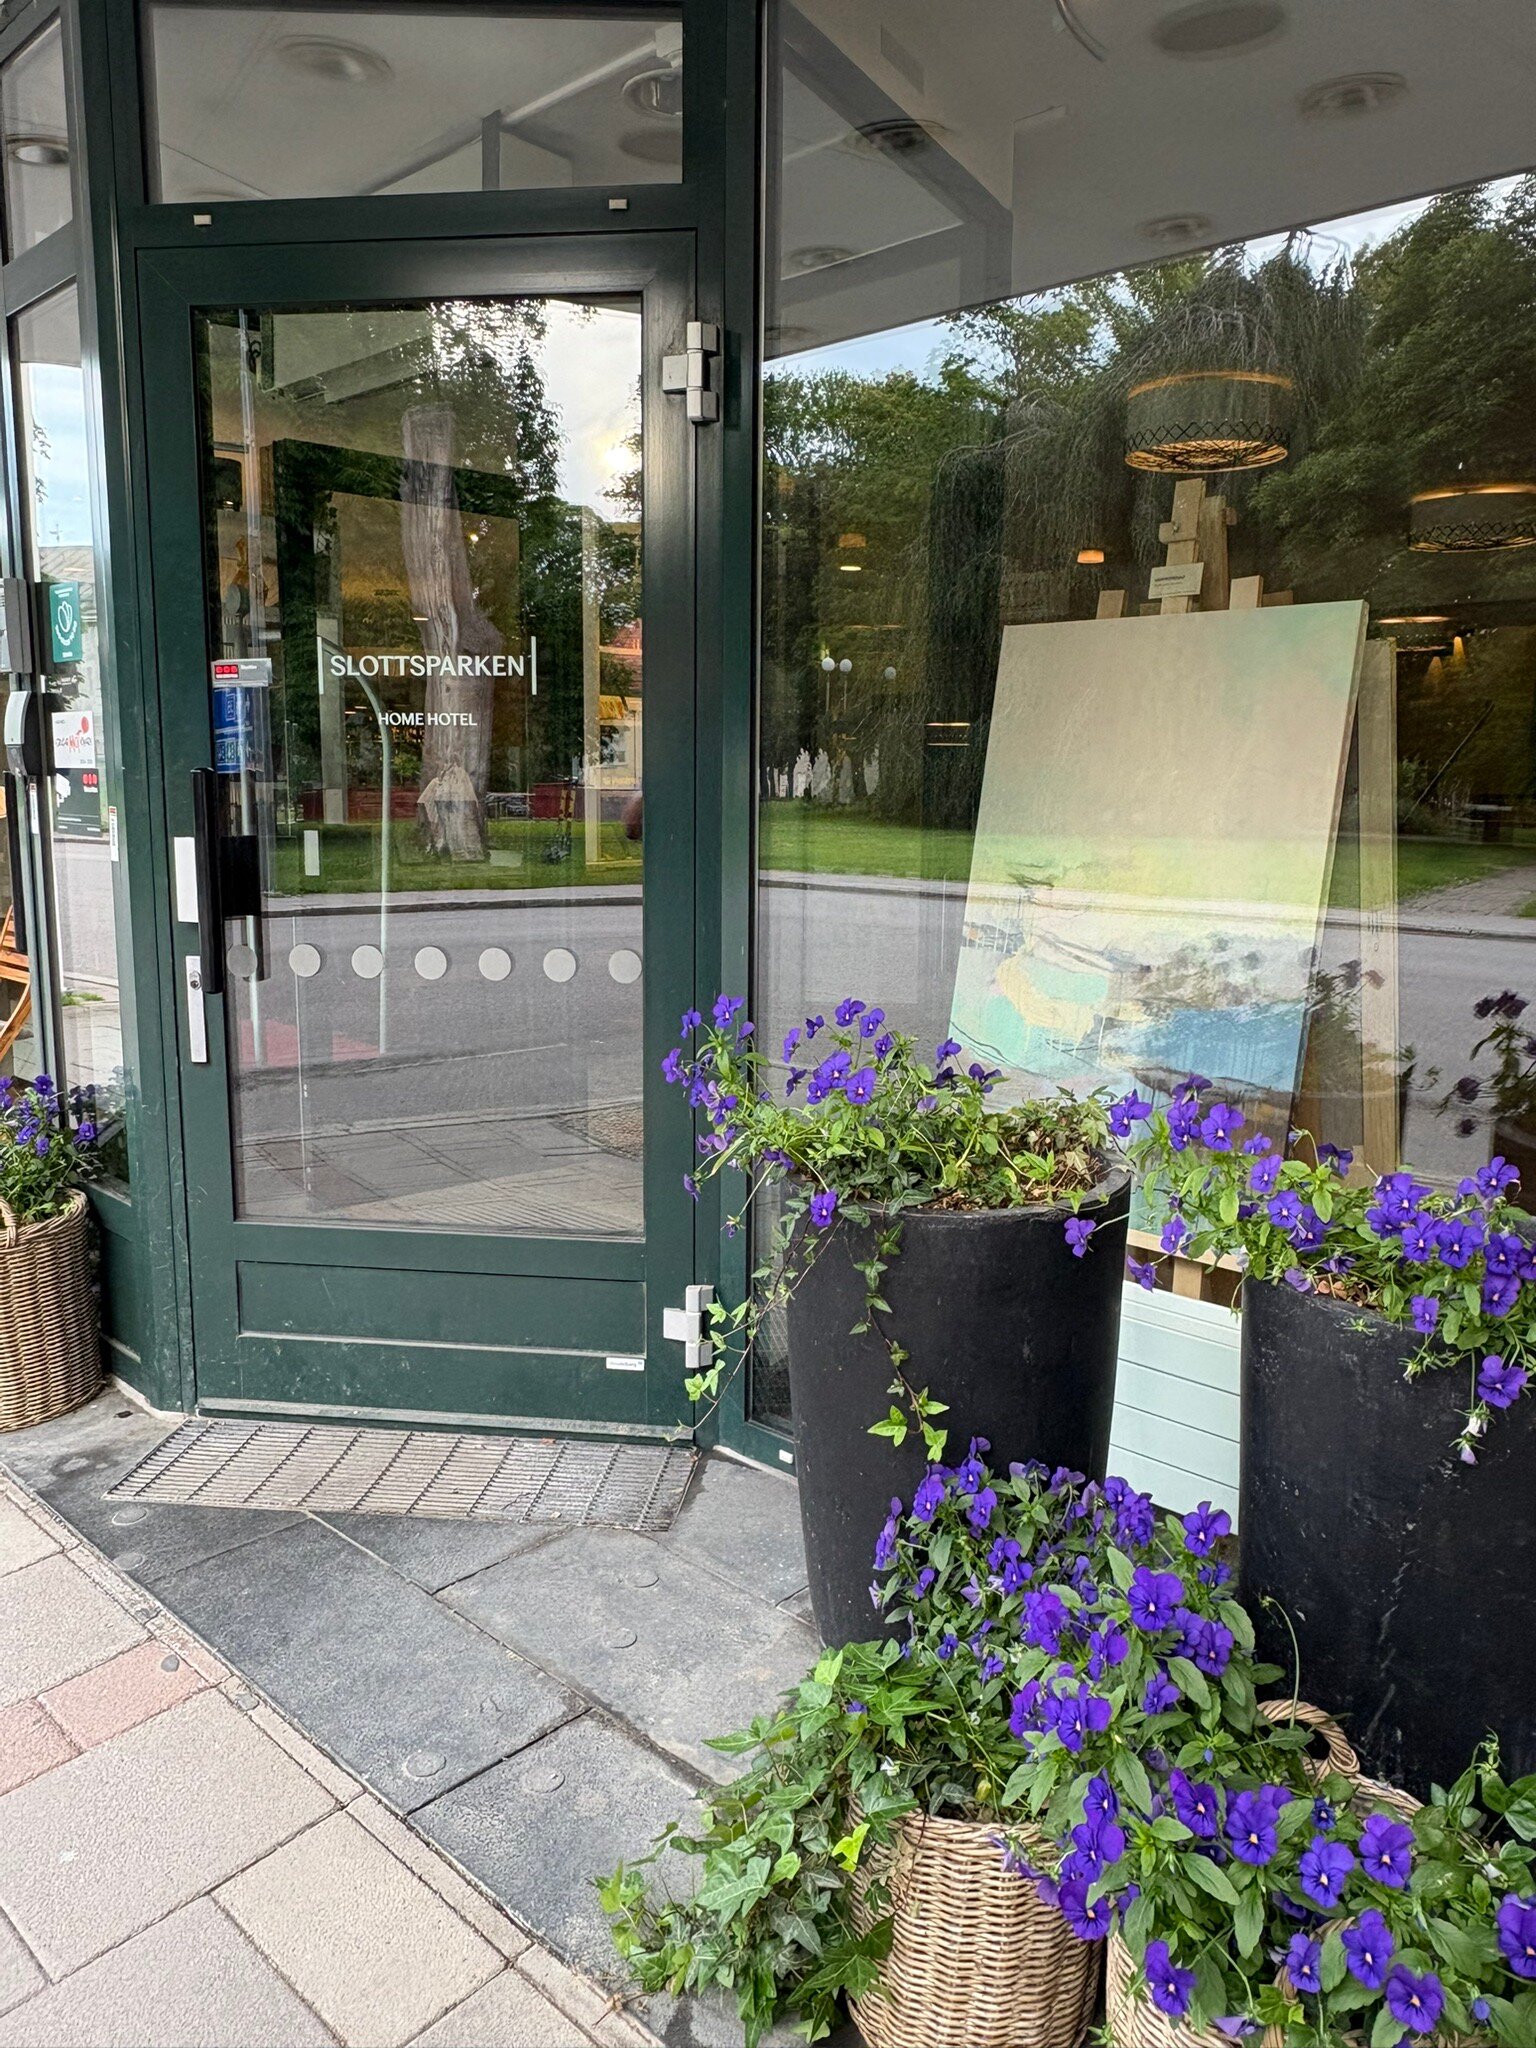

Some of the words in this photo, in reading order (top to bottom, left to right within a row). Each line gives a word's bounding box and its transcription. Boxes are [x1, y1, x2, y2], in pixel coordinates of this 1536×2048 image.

[330, 655, 525, 677] SLOTTSPARKEN
[378, 712, 424, 727] HOME
[427, 712, 478, 727] HOTEL
